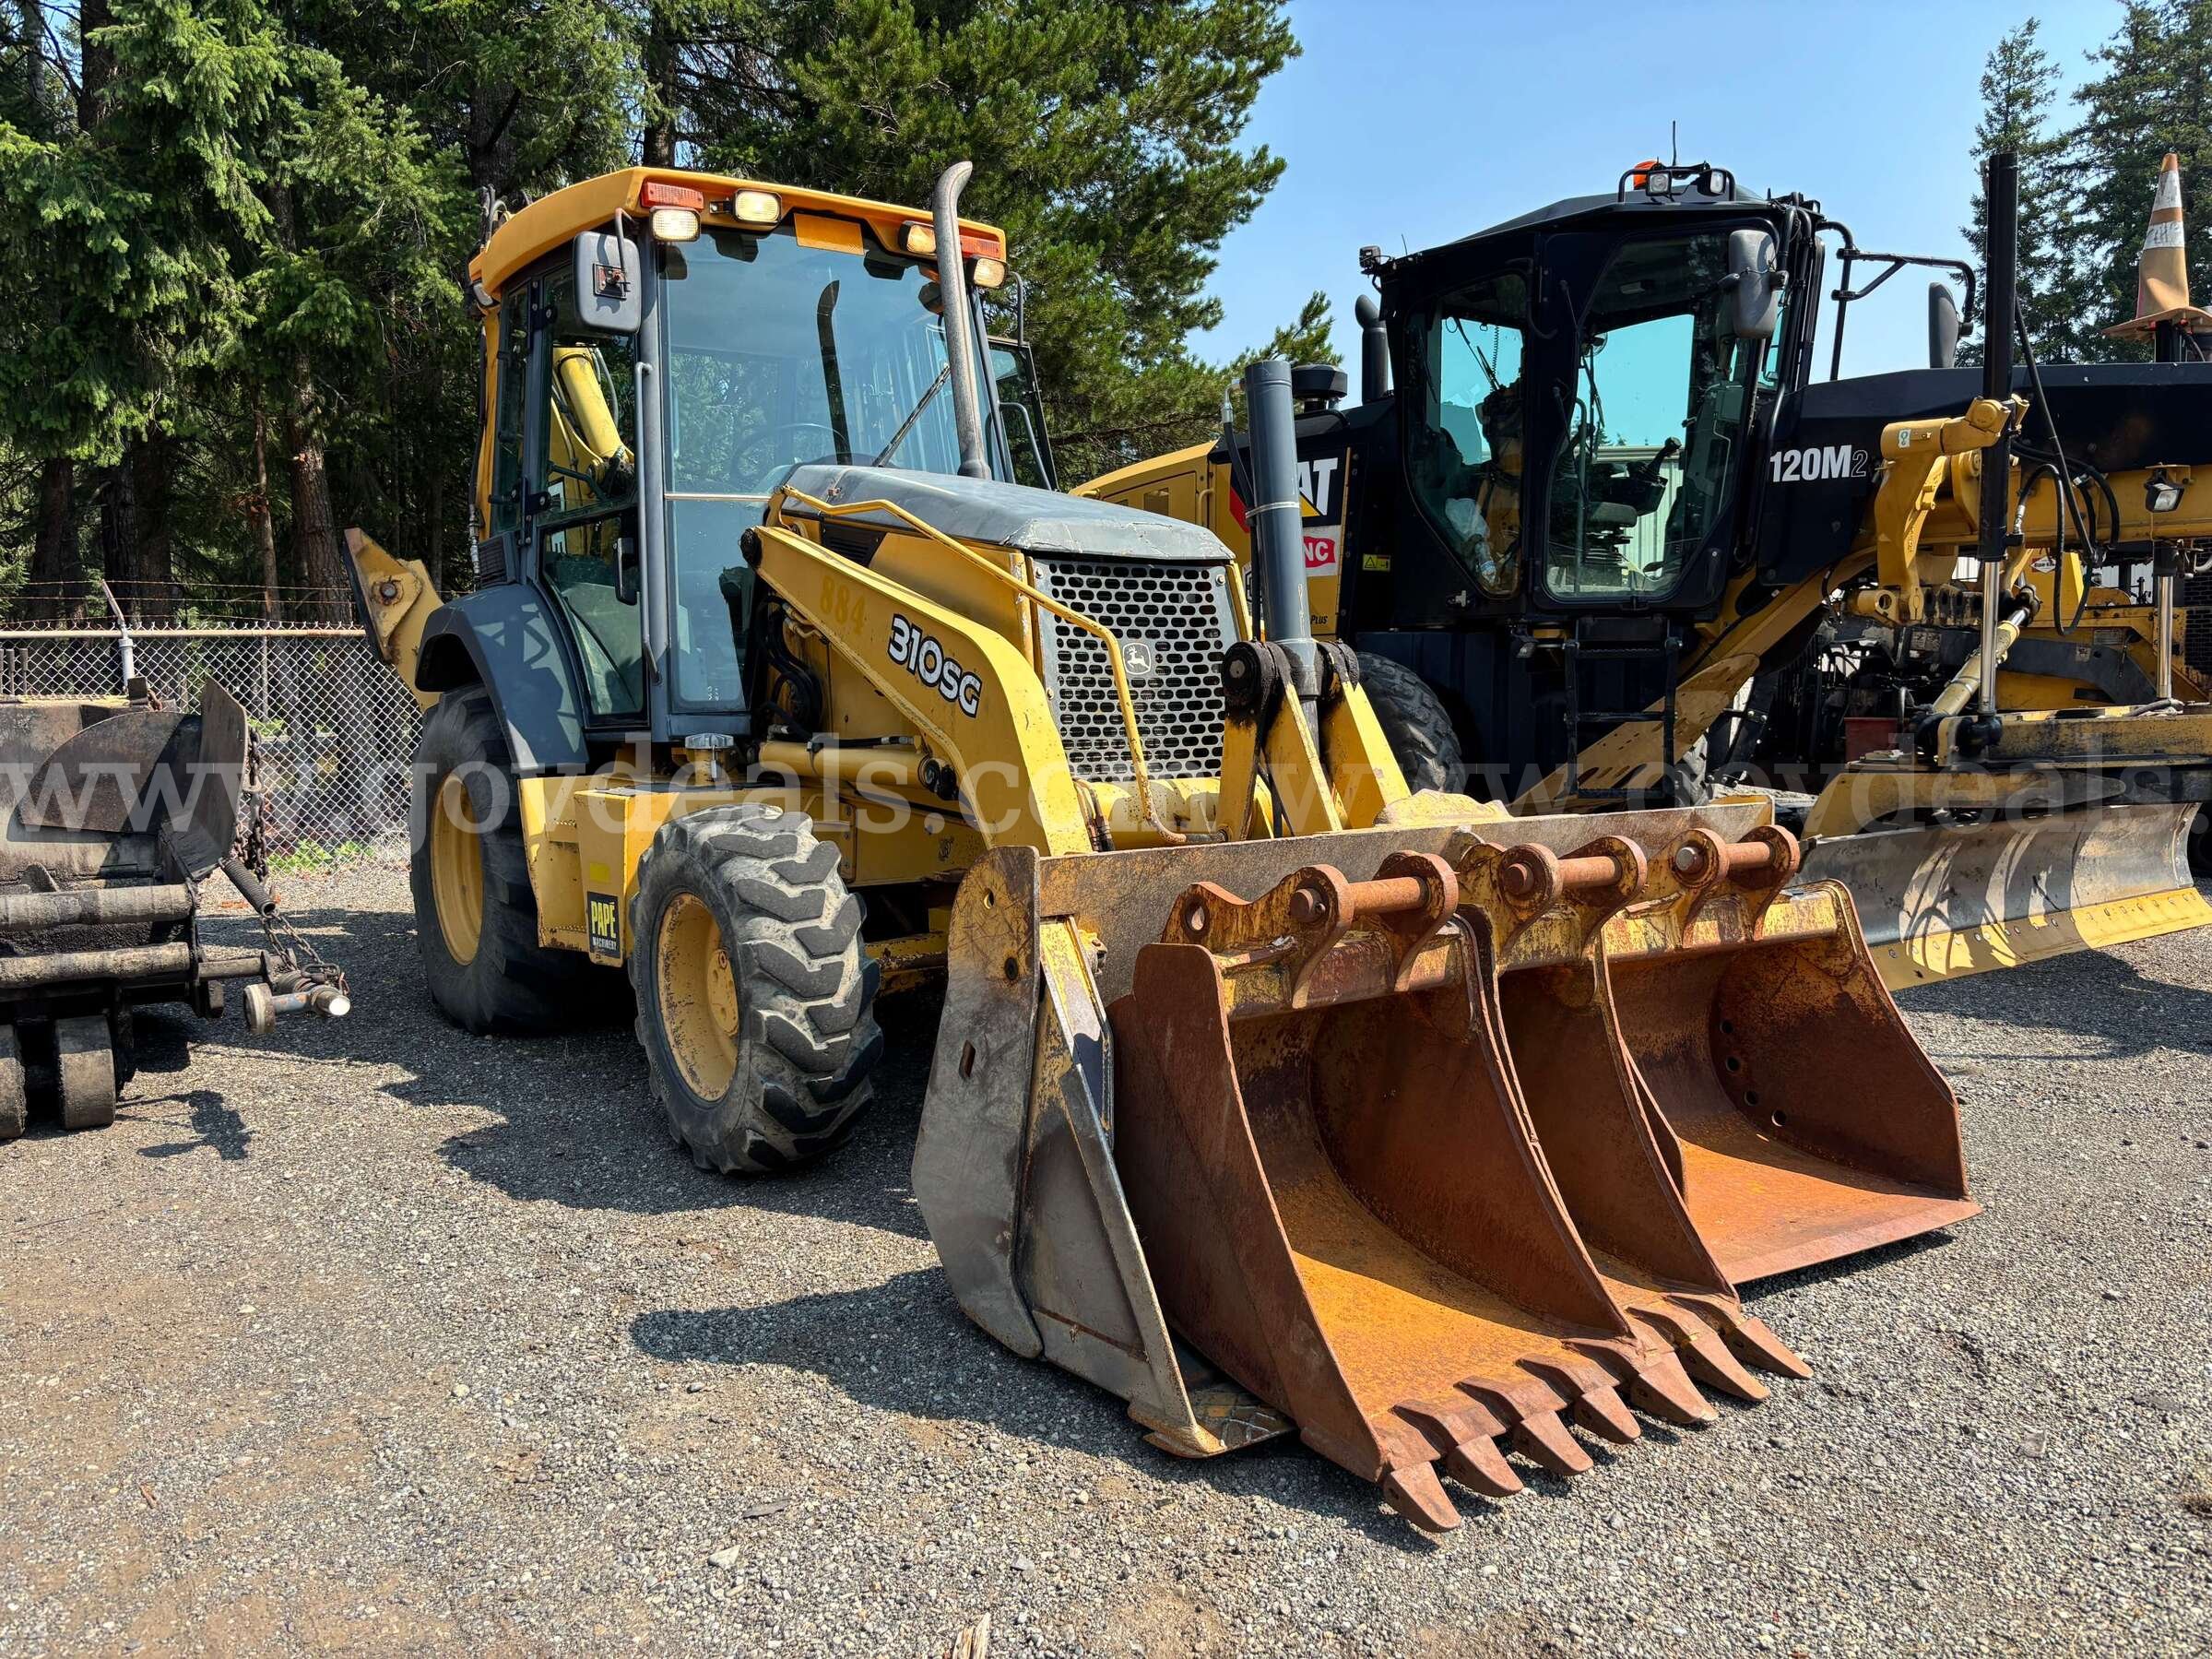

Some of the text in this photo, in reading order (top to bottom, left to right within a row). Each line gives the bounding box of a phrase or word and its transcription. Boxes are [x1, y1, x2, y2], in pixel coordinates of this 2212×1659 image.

[820, 575, 866, 635] 884
[887, 613, 983, 718] 310SG
[590, 900, 617, 939] PAPÉ
